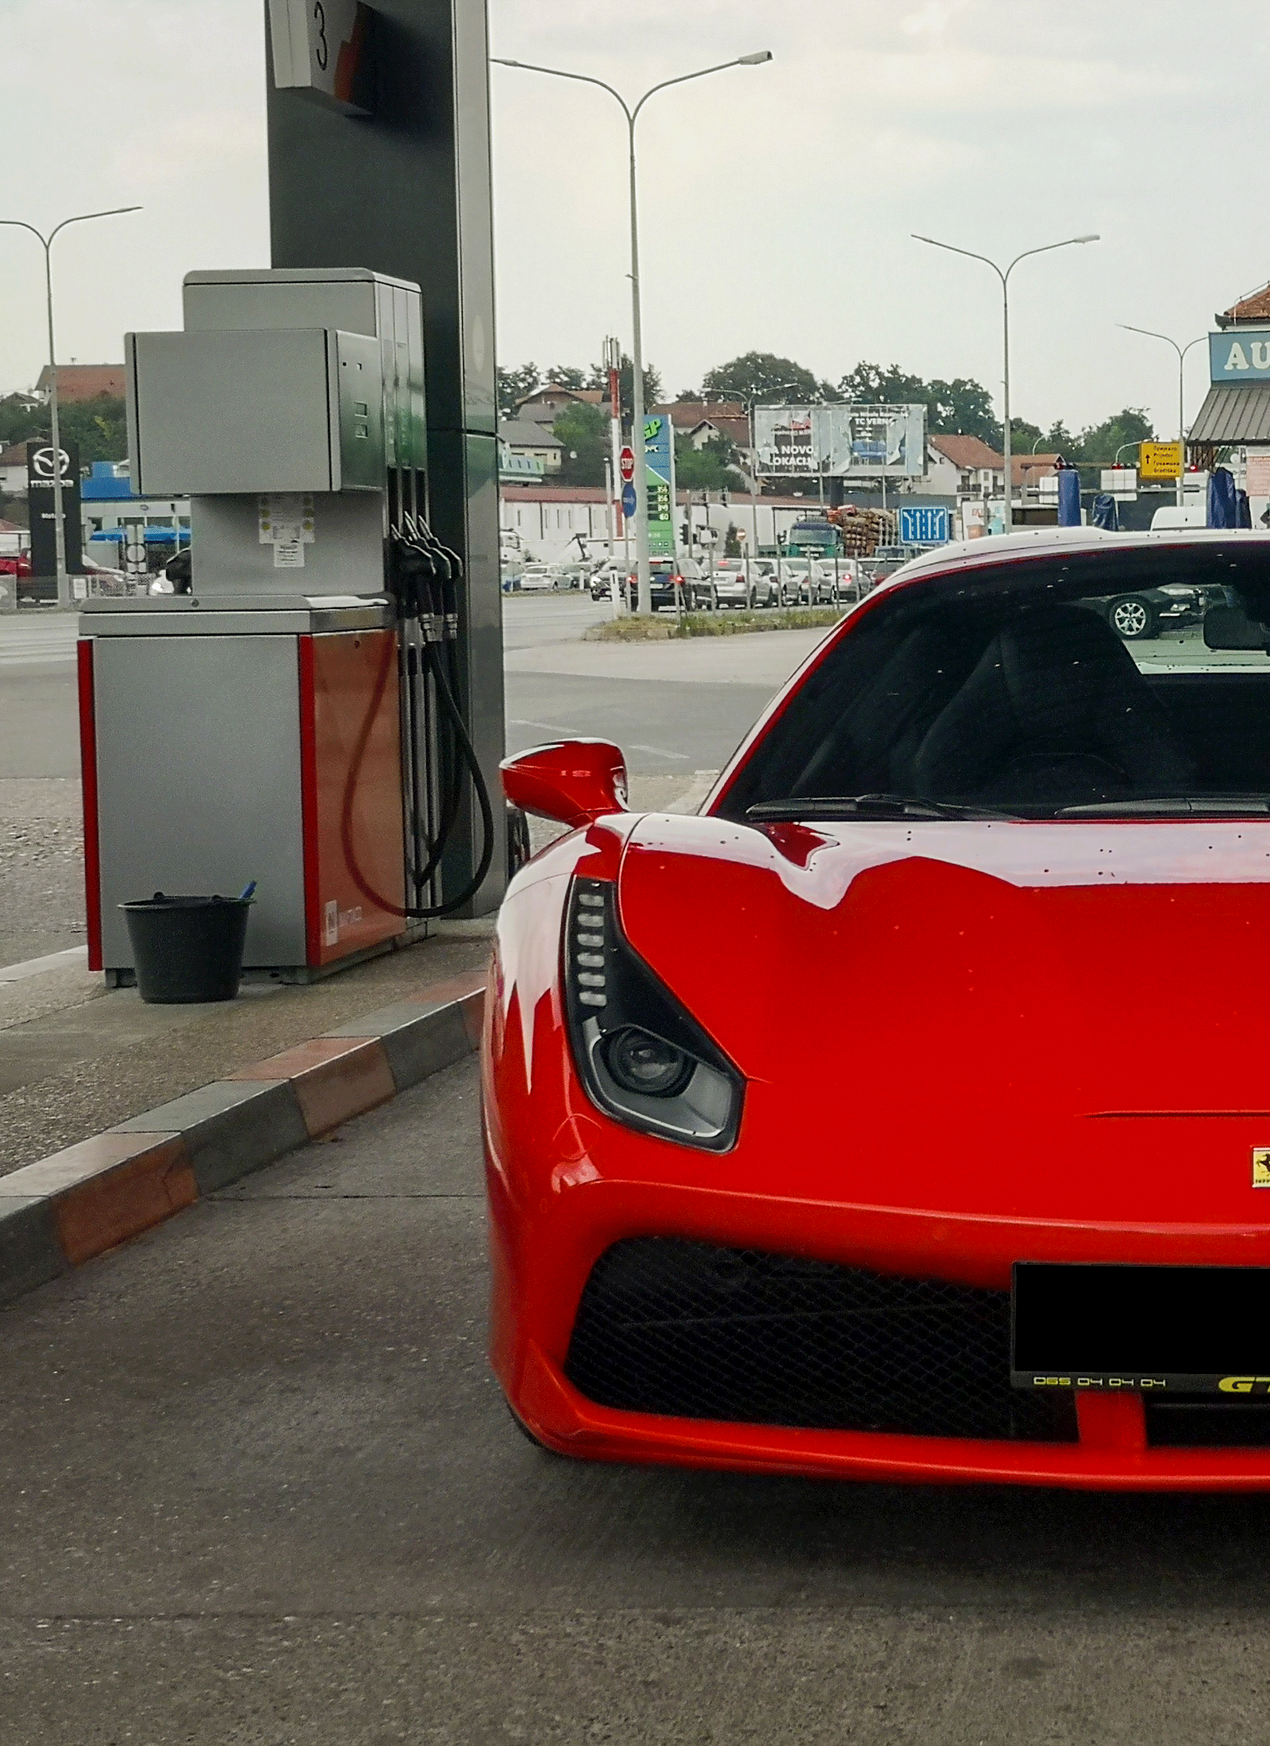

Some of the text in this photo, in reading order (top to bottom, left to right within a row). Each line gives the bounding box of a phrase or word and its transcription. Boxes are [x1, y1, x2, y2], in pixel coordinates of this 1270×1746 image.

[314, 1, 328, 71] 3
[781, 445, 814, 455] NOVO
[621, 458, 633, 470] STOP
[1077, 1377, 1103, 1387] 04
[1109, 1377, 1135, 1387] 04
[1140, 1378, 1166, 1388] 04
